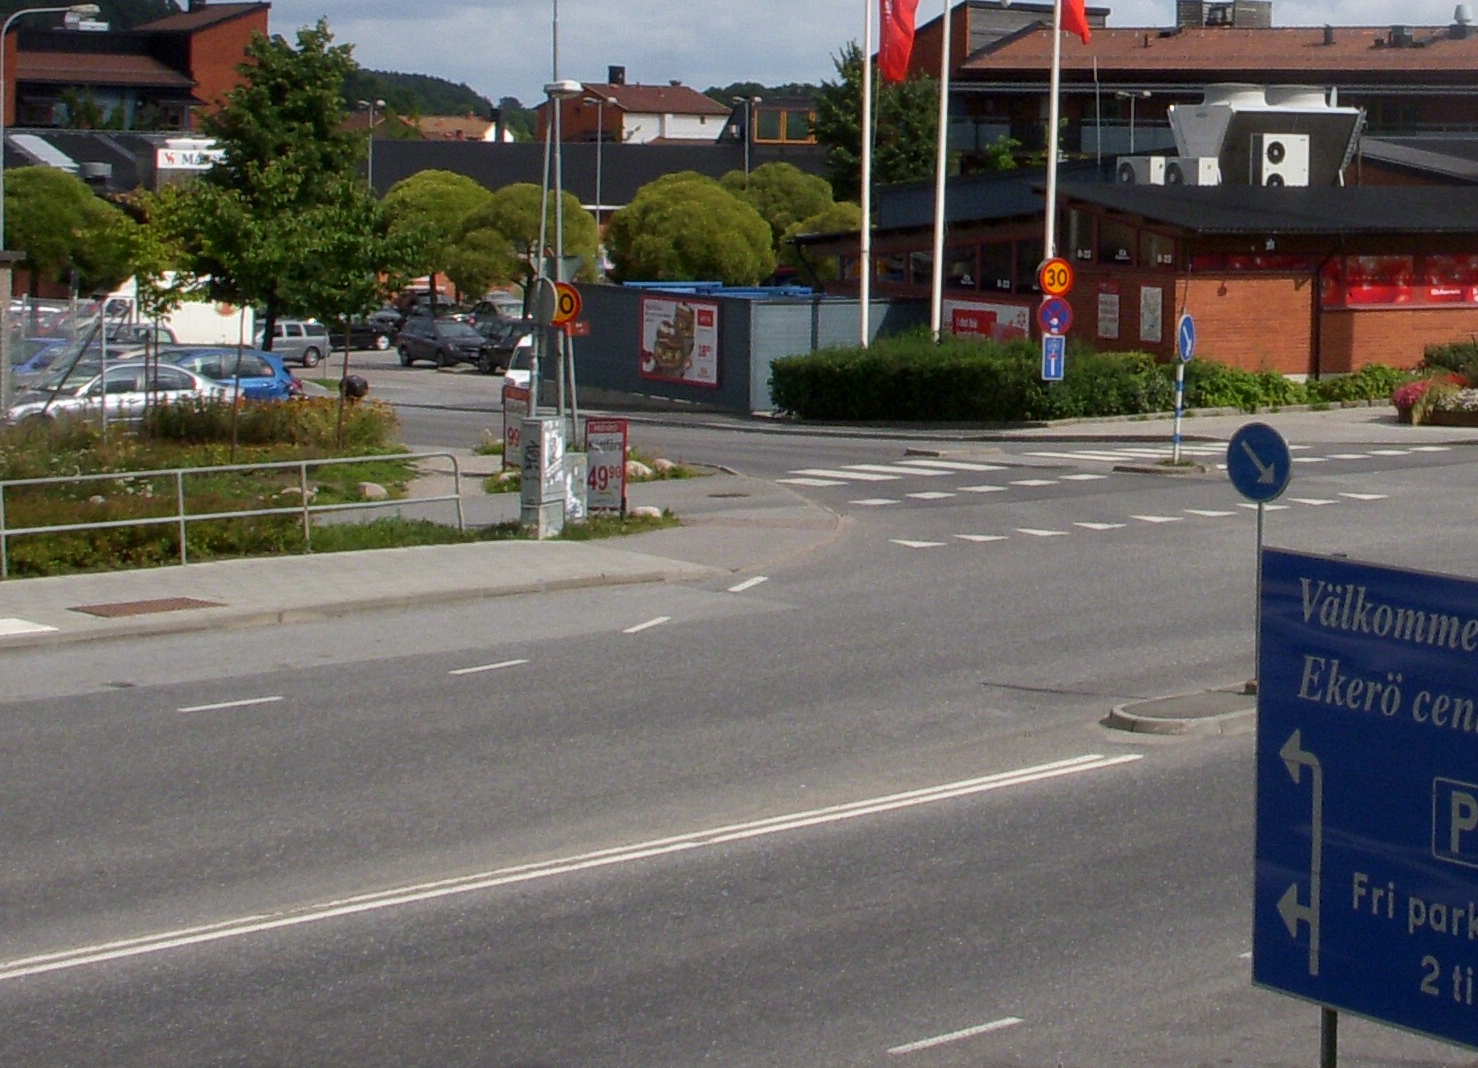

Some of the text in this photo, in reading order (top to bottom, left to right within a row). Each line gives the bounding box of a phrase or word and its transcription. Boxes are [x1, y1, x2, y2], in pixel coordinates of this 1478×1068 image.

[1047, 269, 1067, 287] 30
[587, 465, 608, 492] 49
[1297, 655, 1402, 716] Ekerö
[1353, 872, 1395, 919] Fri
[1420, 955, 1440, 995] 2
